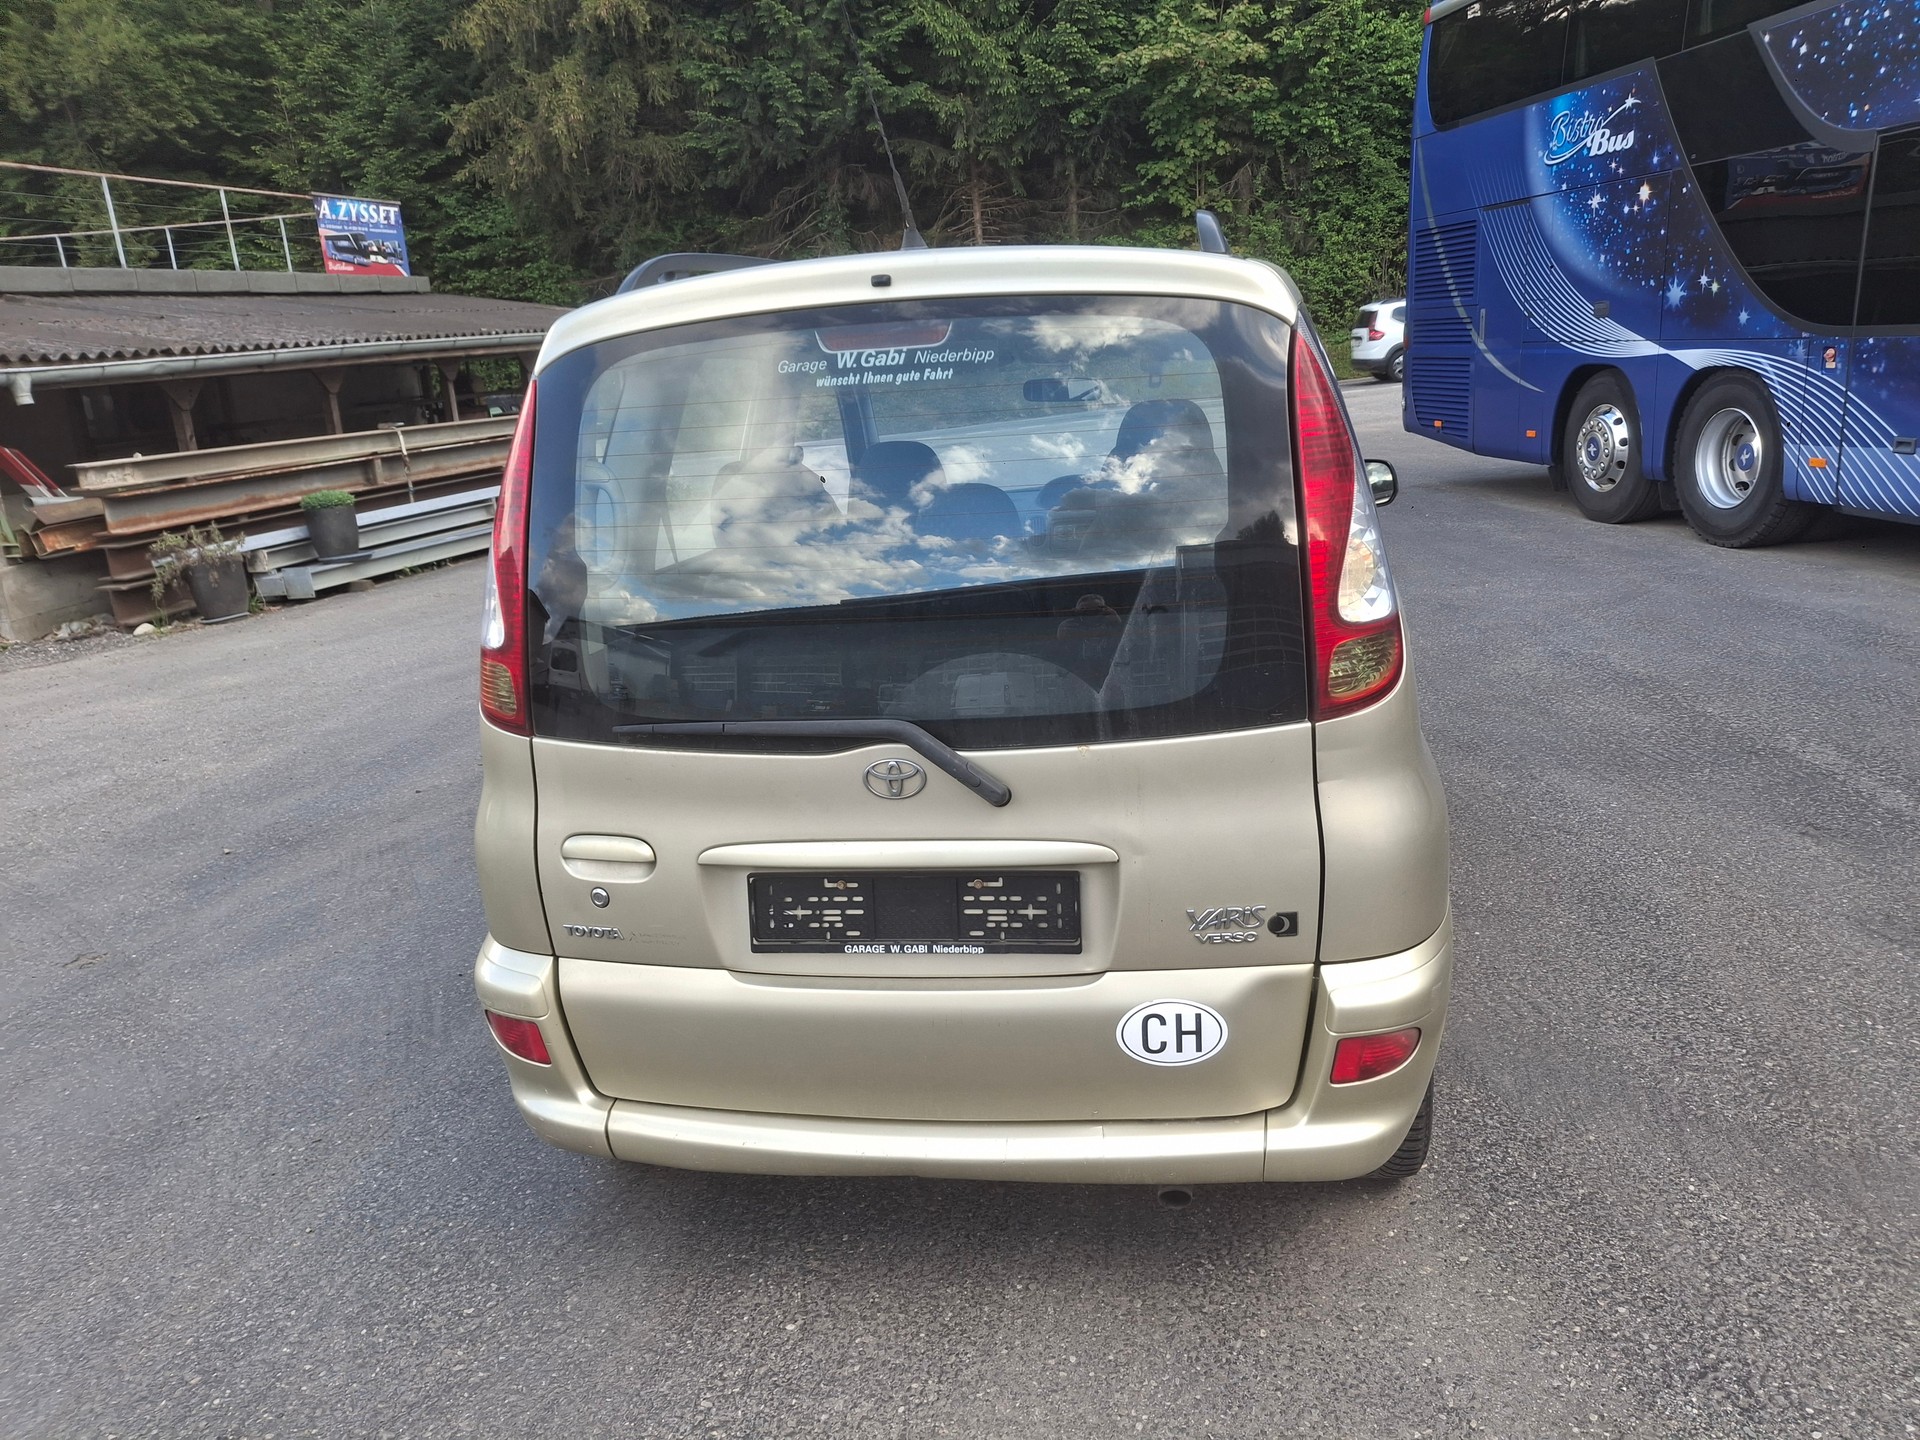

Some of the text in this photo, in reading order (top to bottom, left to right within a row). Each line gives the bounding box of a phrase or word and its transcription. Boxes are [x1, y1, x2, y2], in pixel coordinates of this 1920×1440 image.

[1551, 110, 1604, 147] Bistro
[1589, 128, 1634, 156] Bus
[778, 359, 828, 374] Garage
[914, 348, 995, 364] Niederbipp
[816, 367, 954, 388] wünscht Ihnen gute Fahrt
[562, 924, 624, 940] TOYOTA
[1194, 931, 1259, 944] VERSO
[844, 944, 886, 954] GARAGE
[932, 944, 985, 955] Niederbipp
[1141, 1012, 1203, 1055] CH
